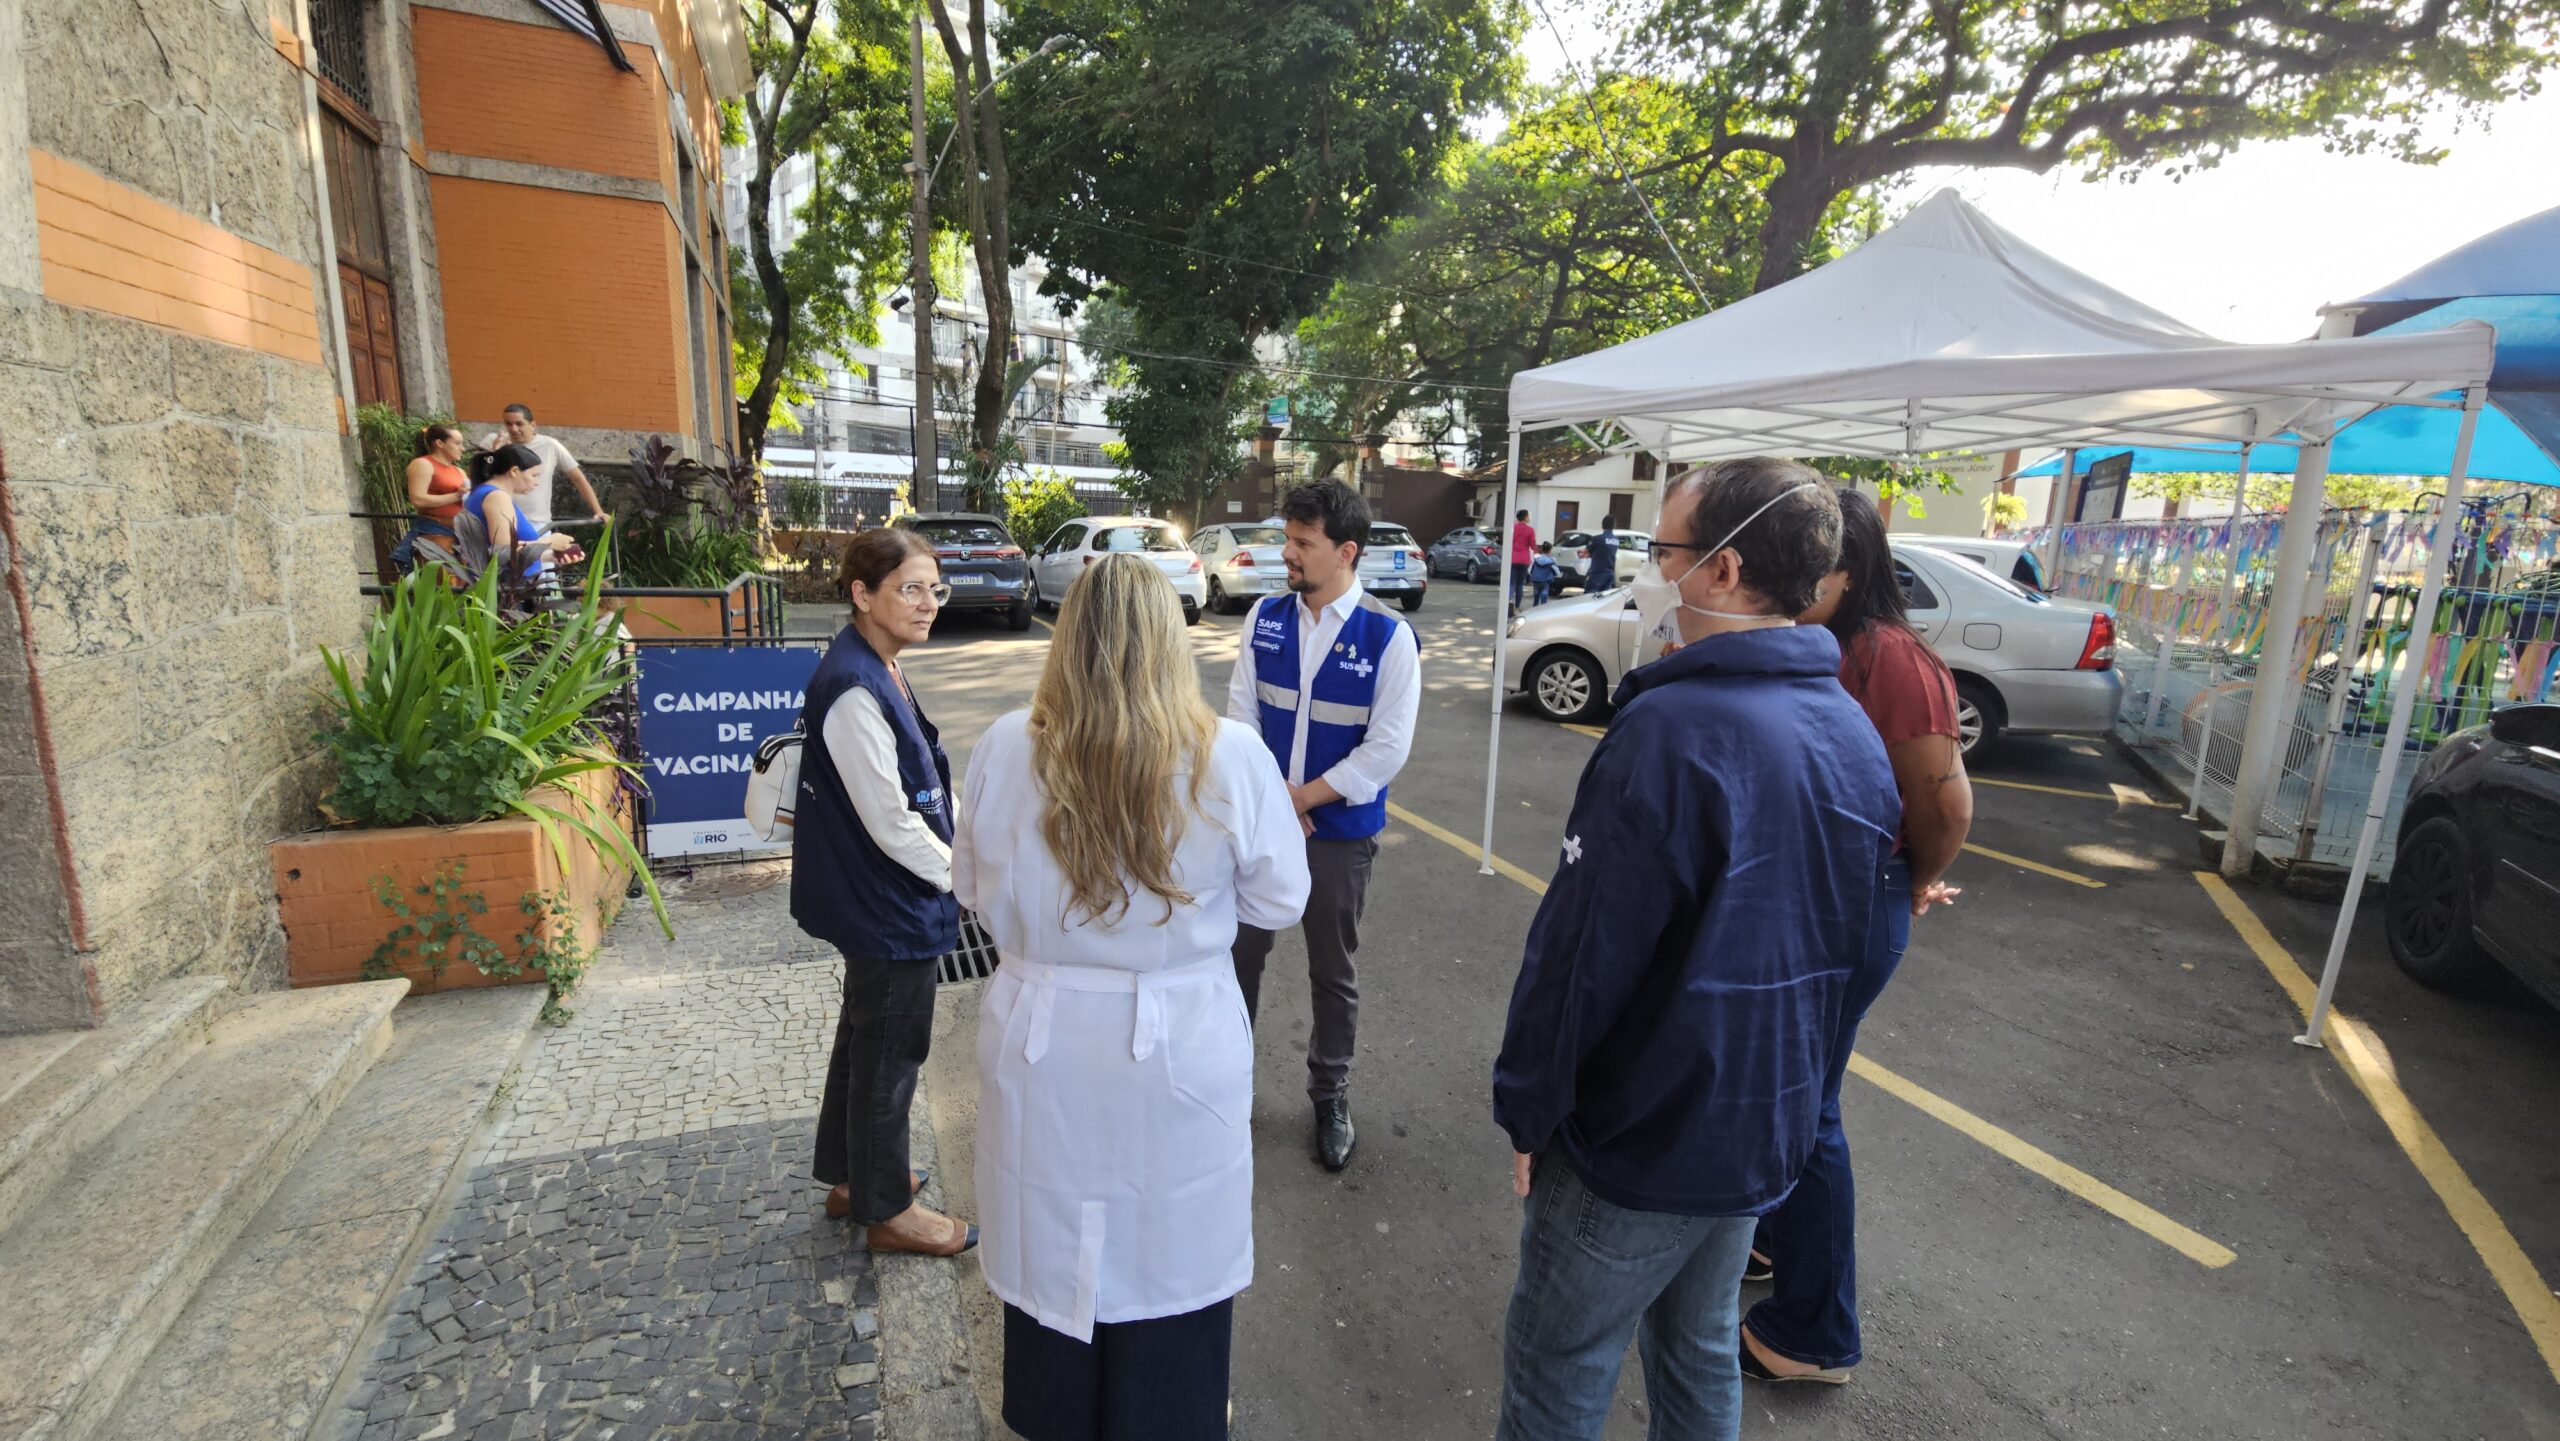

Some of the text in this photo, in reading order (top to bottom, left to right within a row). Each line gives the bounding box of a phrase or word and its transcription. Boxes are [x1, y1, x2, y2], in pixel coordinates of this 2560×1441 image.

[1258, 619, 1283, 631] SAPS
[1339, 661, 1355, 671] SUS
[653, 690, 806, 713] CAMPANHA
[718, 722, 754, 743] DE
[653, 753, 753, 776] VACINA
[705, 833, 728, 844] RIO
